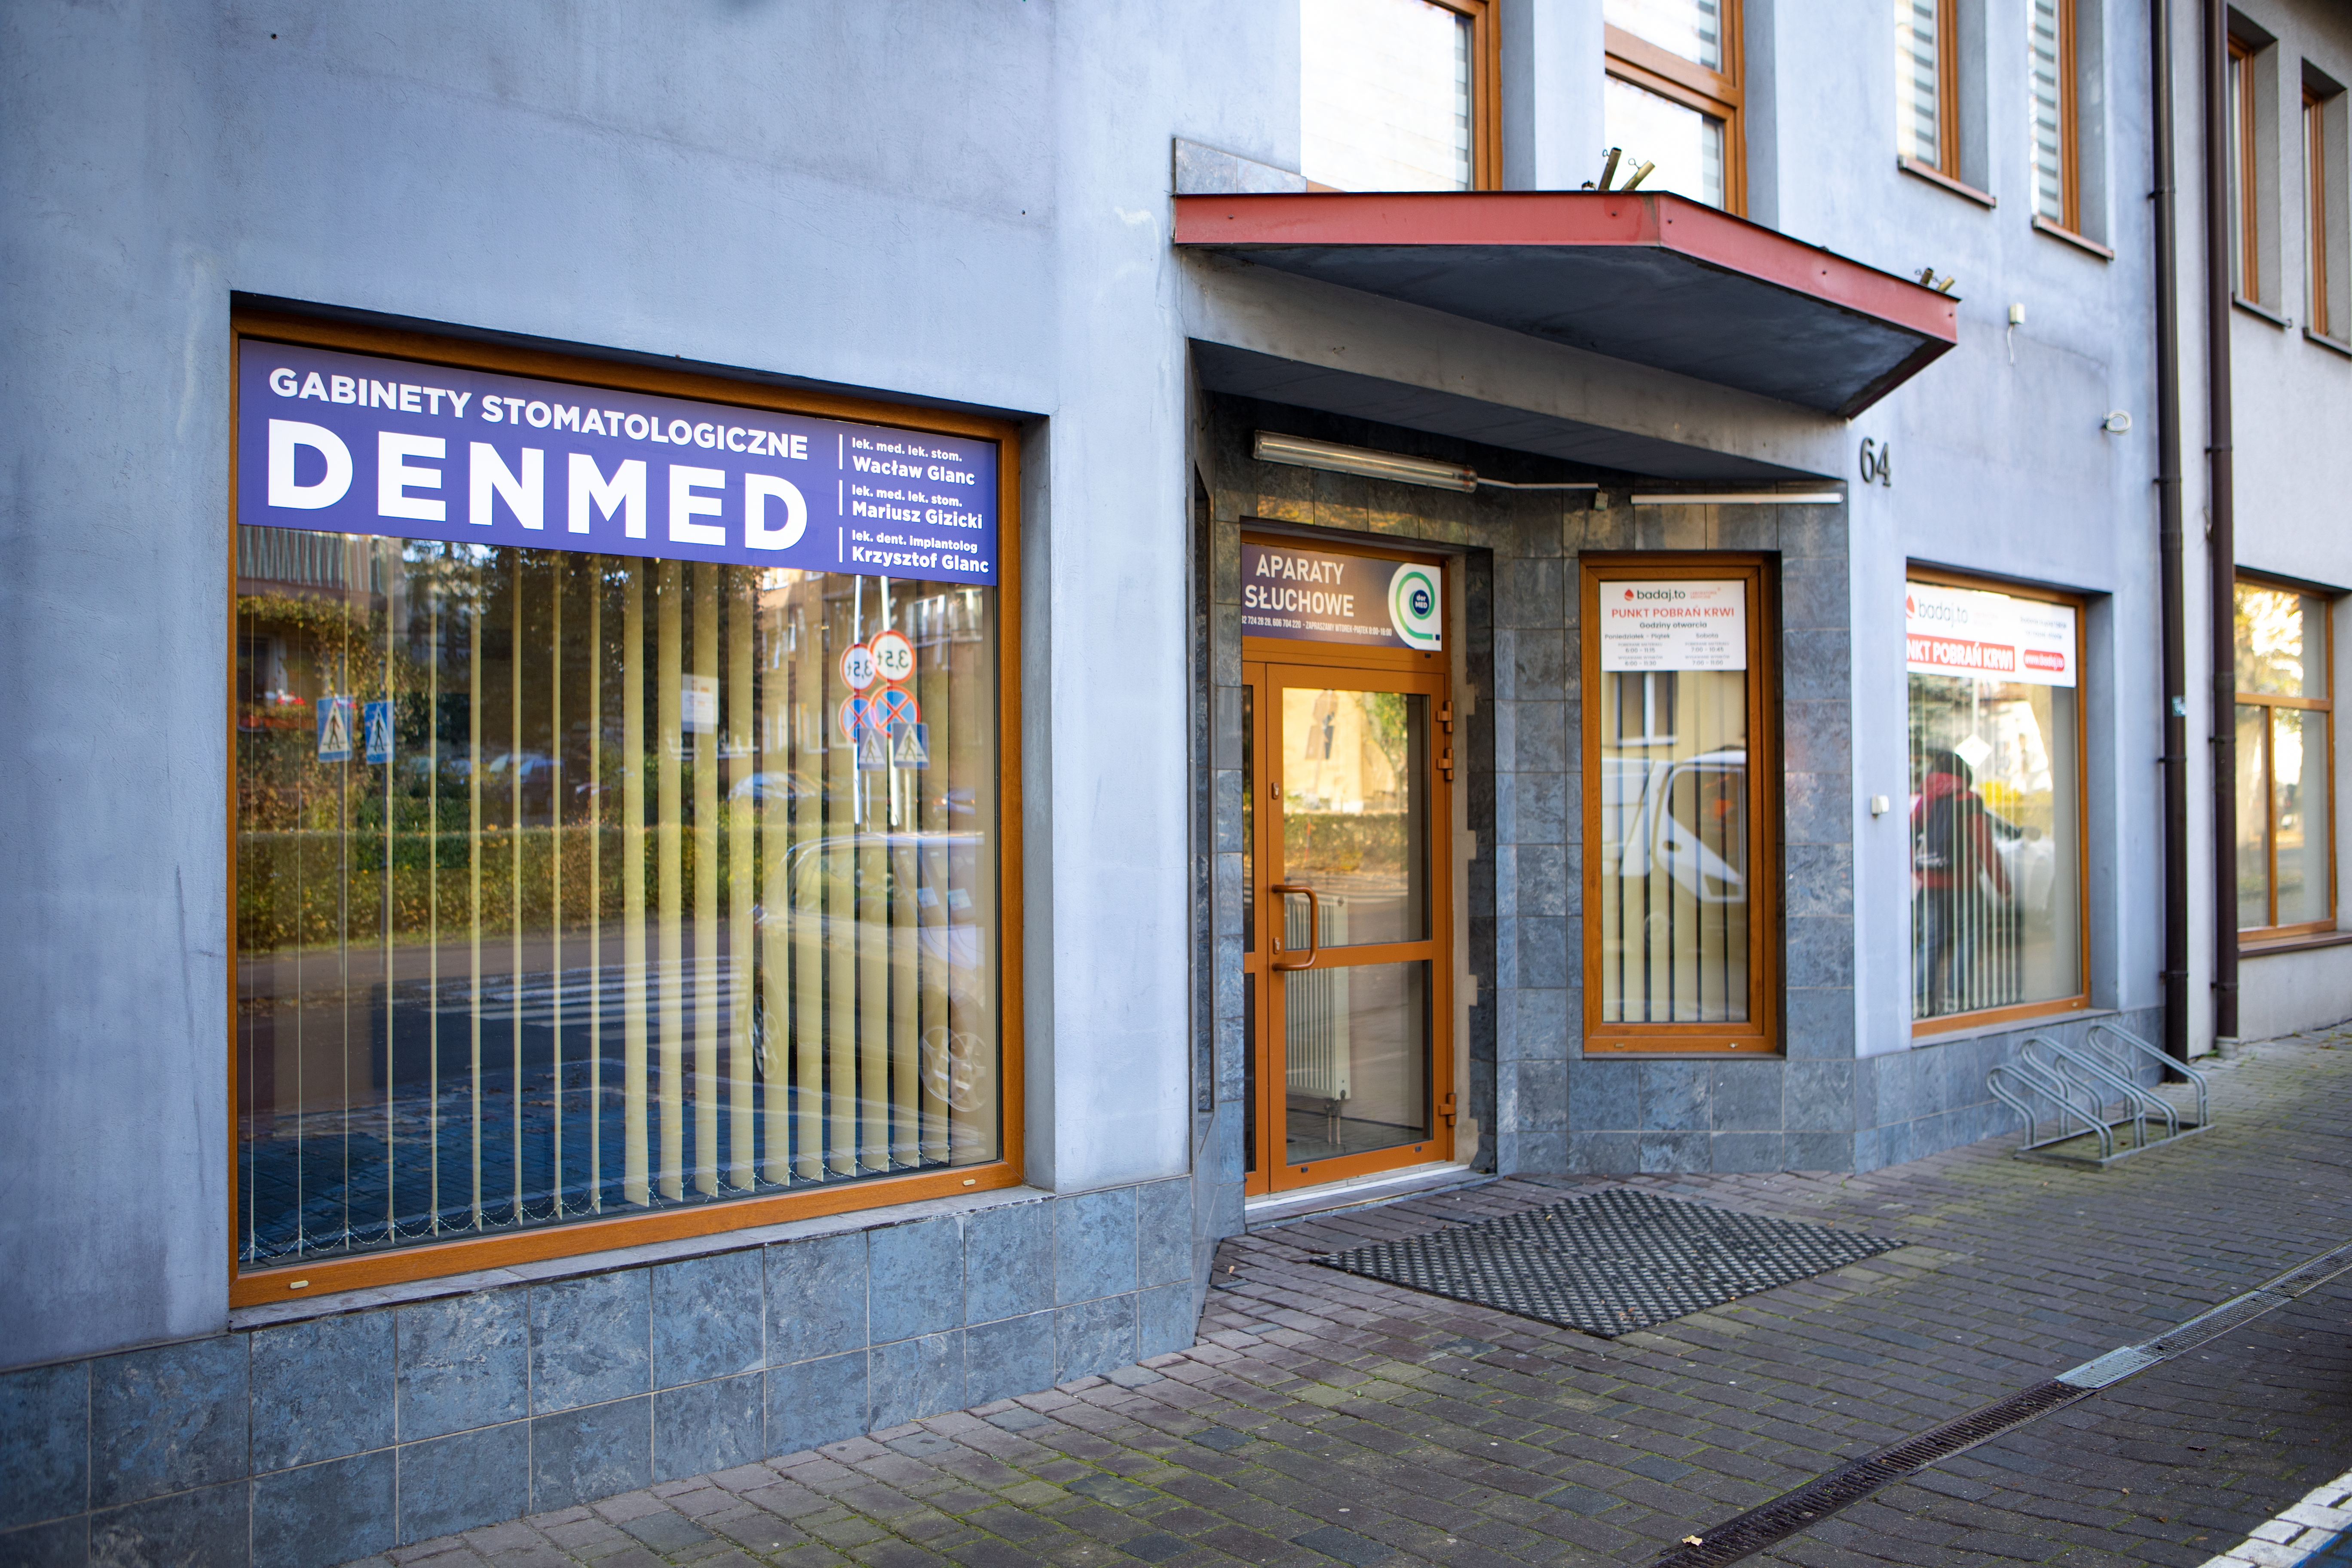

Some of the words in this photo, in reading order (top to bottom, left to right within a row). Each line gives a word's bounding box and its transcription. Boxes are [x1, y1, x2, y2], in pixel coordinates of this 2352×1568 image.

[269, 368, 472, 419] GABINETY
[481, 395, 808, 461] STOMATOLOGICZNE
[852, 437, 873, 450] lek.
[876, 442, 905, 454] med.
[908, 445, 928, 457] lek.
[931, 450, 962, 462] stom.
[1861, 437, 1891, 487] 64
[268, 418, 807, 551] DENMED
[852, 455, 923, 479] Wacław
[927, 466, 975, 485] Glanc
[852, 484, 873, 497] lek.
[876, 489, 905, 501] med.
[908, 490, 928, 503] lek.
[931, 495, 962, 507] stom.
[852, 500, 921, 523] Mariusz
[925, 508, 983, 529] Gizicki
[852, 530, 873, 542] lek.
[876, 532, 906, 545] dent.
[910, 535, 978, 554] implantolog
[852, 546, 937, 568] Krzysztof
[942, 554, 989, 573] Glanc
[1256, 554, 1344, 585] APARATY
[1245, 584, 1354, 617] SŁUCHOWE
[1637, 589, 1686, 602] badaj.to
[1247, 615, 1257, 625] 724
[1273, 618, 1282, 628] 606
[1283, 619, 1292, 628] 704
[1292, 620, 1302, 629] 220
[1306, 621, 1335, 631] ZAPRASZAMY
[1612, 608, 1650, 619] PUNKT
[1653, 606, 1700, 618] POBRAŃ
[1704, 607, 1734, 618] KRWI
[1640, 621, 1671, 630] Godziny
[1918, 598, 1968, 628] badaj.to
[1932, 641, 1982, 667] POBRAŃ
[1983, 646, 2014, 671] KRWI
